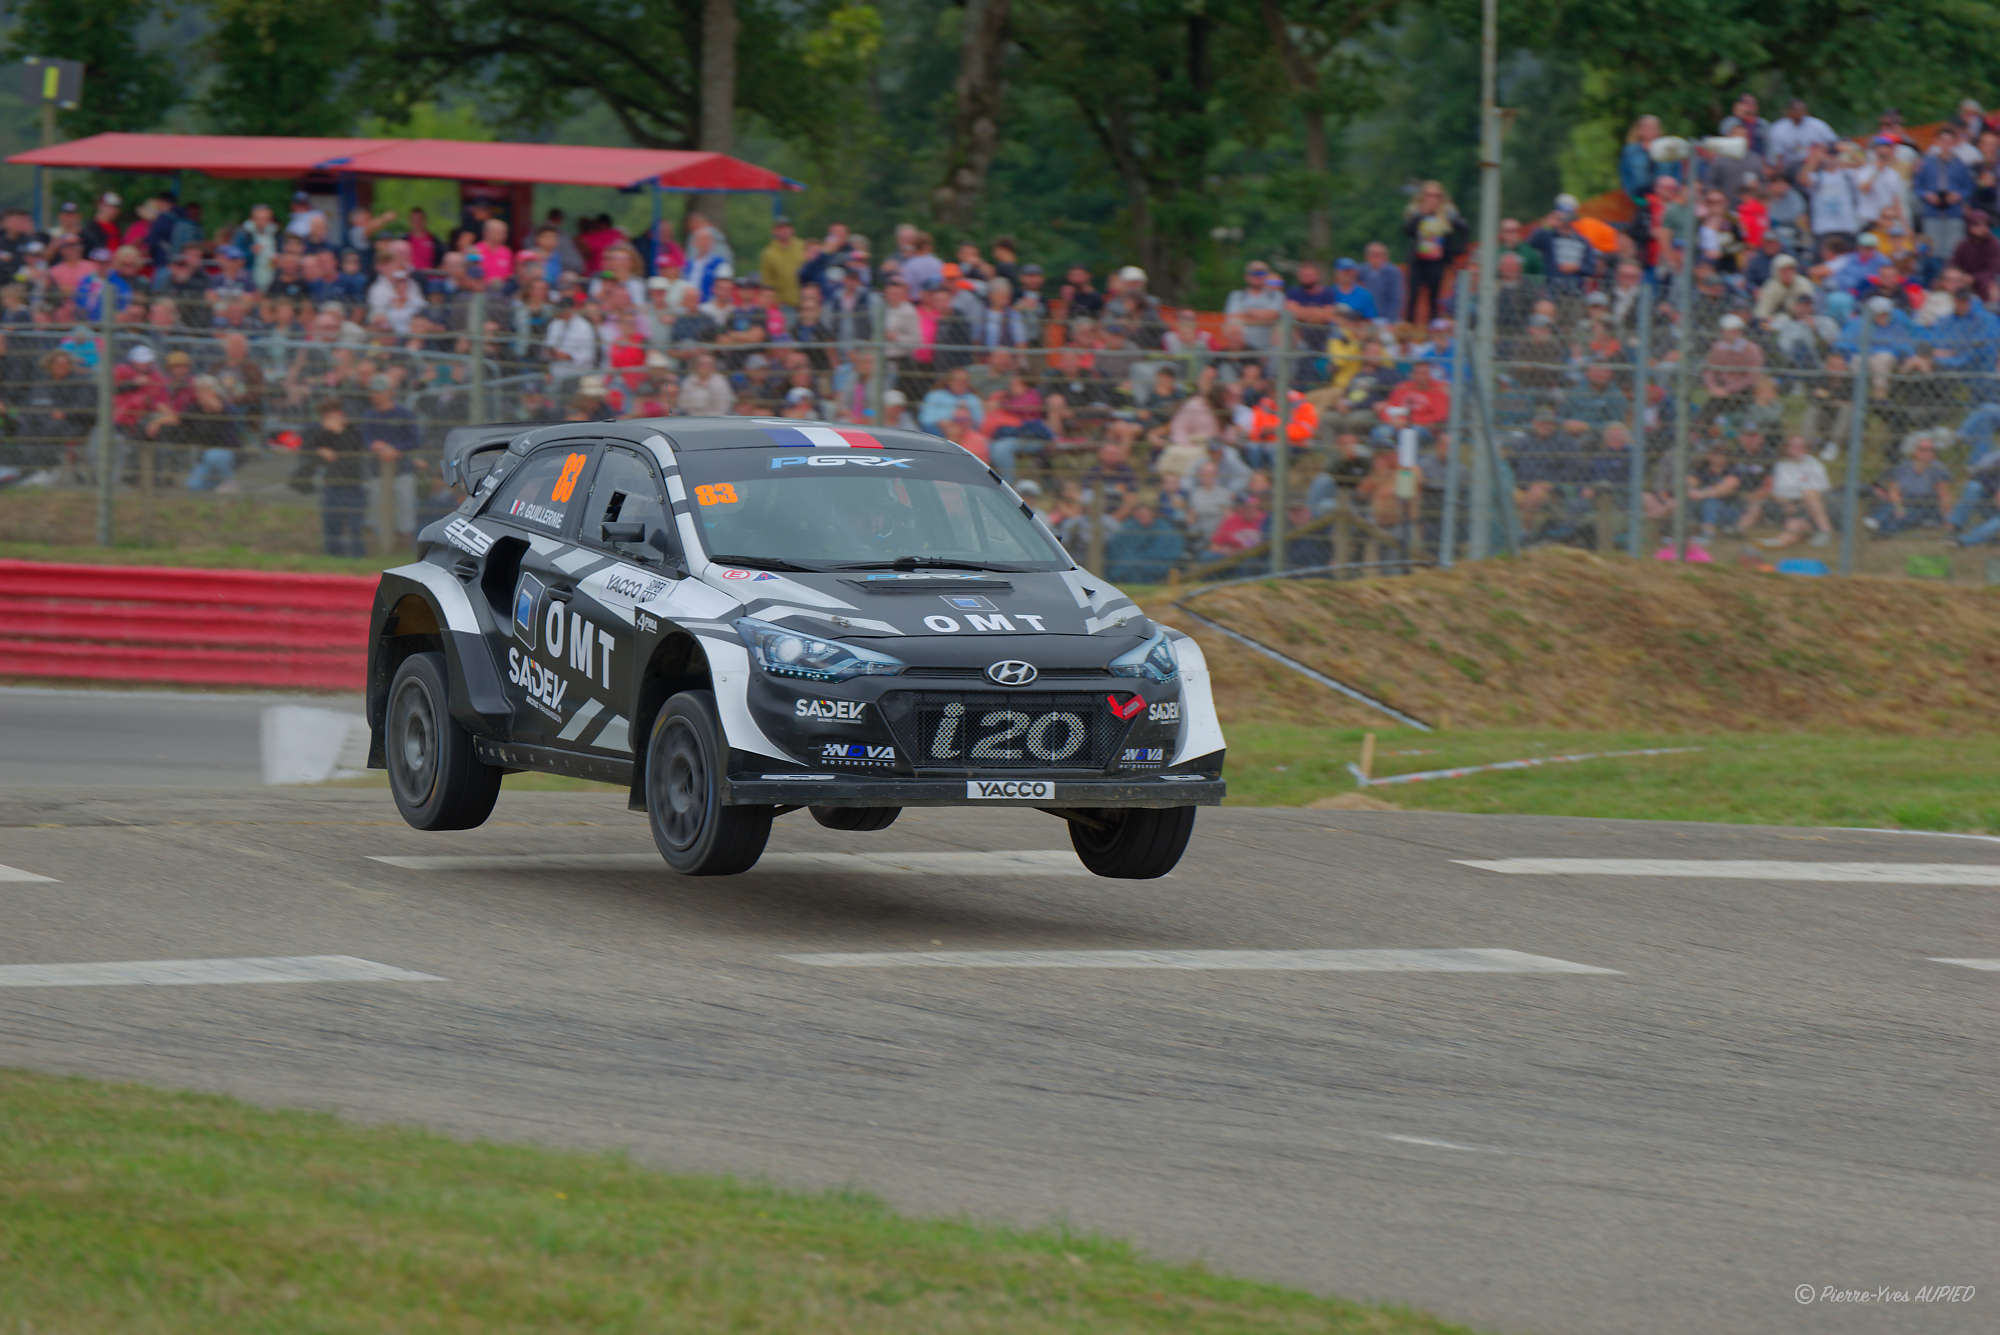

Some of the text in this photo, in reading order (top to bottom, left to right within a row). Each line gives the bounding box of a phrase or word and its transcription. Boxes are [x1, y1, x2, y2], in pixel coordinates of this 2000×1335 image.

[770, 455, 914, 469] PGRX
[551, 452, 587, 503] 83
[694, 482, 739, 506] 83
[525, 503, 564, 529] GUILLERME
[606, 574, 643, 599] YACCO
[923, 614, 1047, 633] OMT
[545, 600, 615, 690] OMT
[508, 647, 568, 710] SADEV
[795, 699, 867, 719] SADEV
[930, 702, 1088, 760] i20
[977, 782, 1046, 797] YACCO
